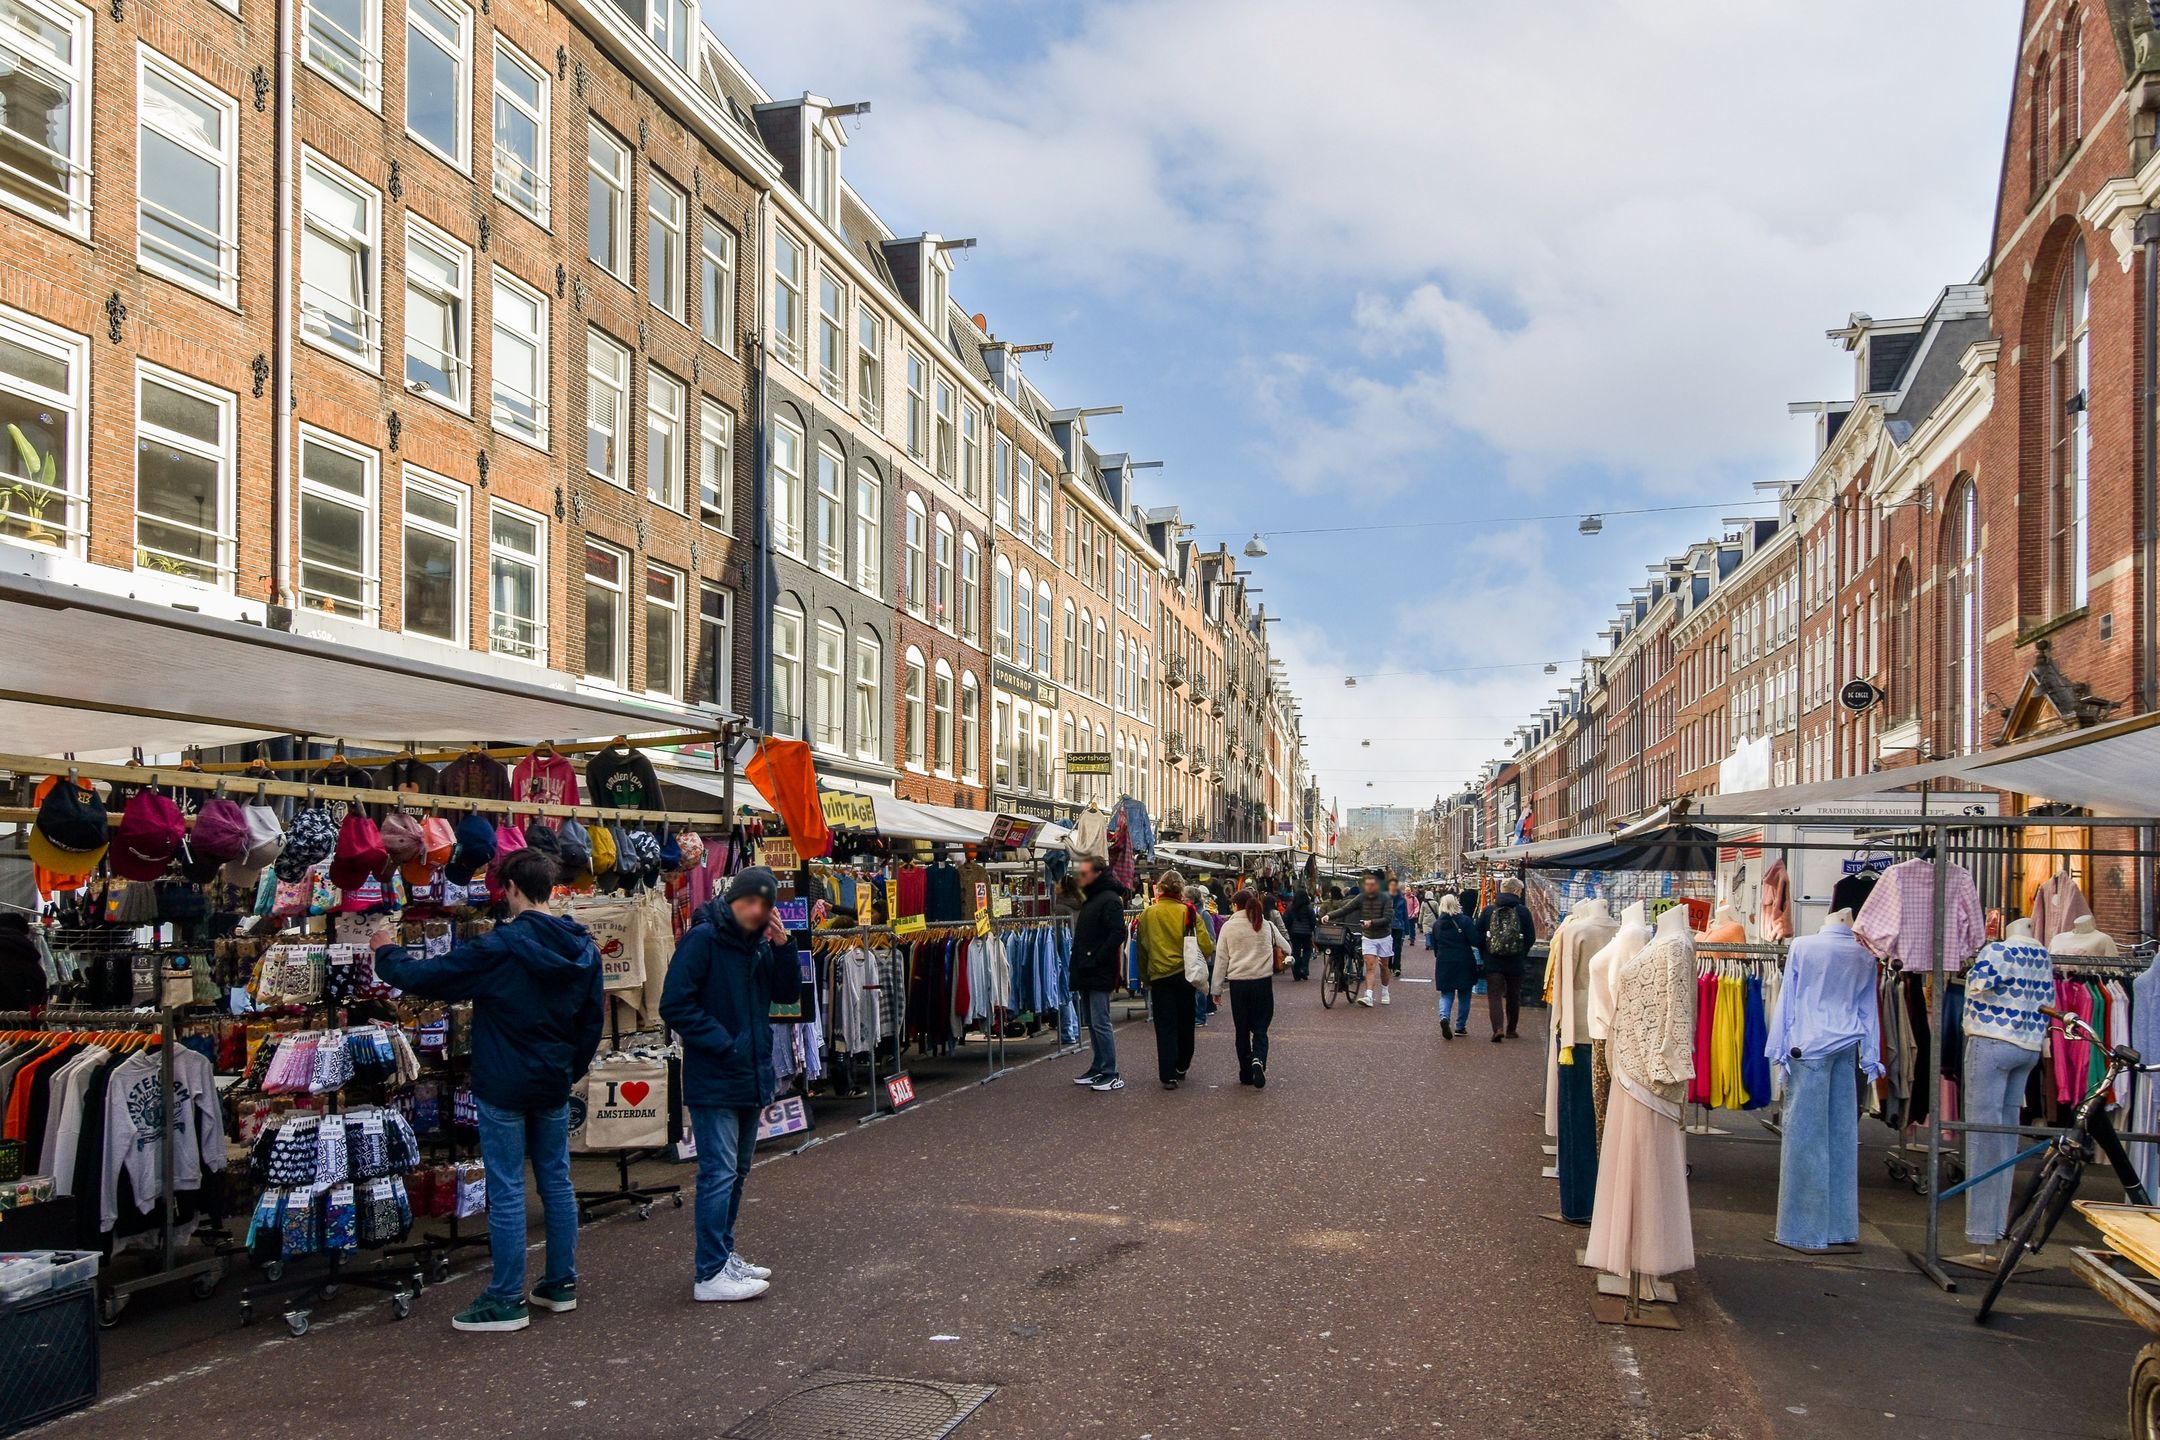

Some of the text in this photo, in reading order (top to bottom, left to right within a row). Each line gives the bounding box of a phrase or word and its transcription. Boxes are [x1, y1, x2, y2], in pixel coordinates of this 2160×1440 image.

[996, 669, 1032, 691] SPORTSHOP
[1067, 753, 1110, 762] Sportshop
[1018, 805, 1051, 818] SPORTSHOP
[1817, 807, 1877, 815] TRADITIONEEL
[764, 853, 797, 868] SALE!
[976, 884, 987, 896] 25
[605, 961, 631, 973] AND
[605, 1081, 618, 1107] I
[891, 1078, 913, 1104] SALE
[596, 1108, 656, 1119] AMSTERDAM
